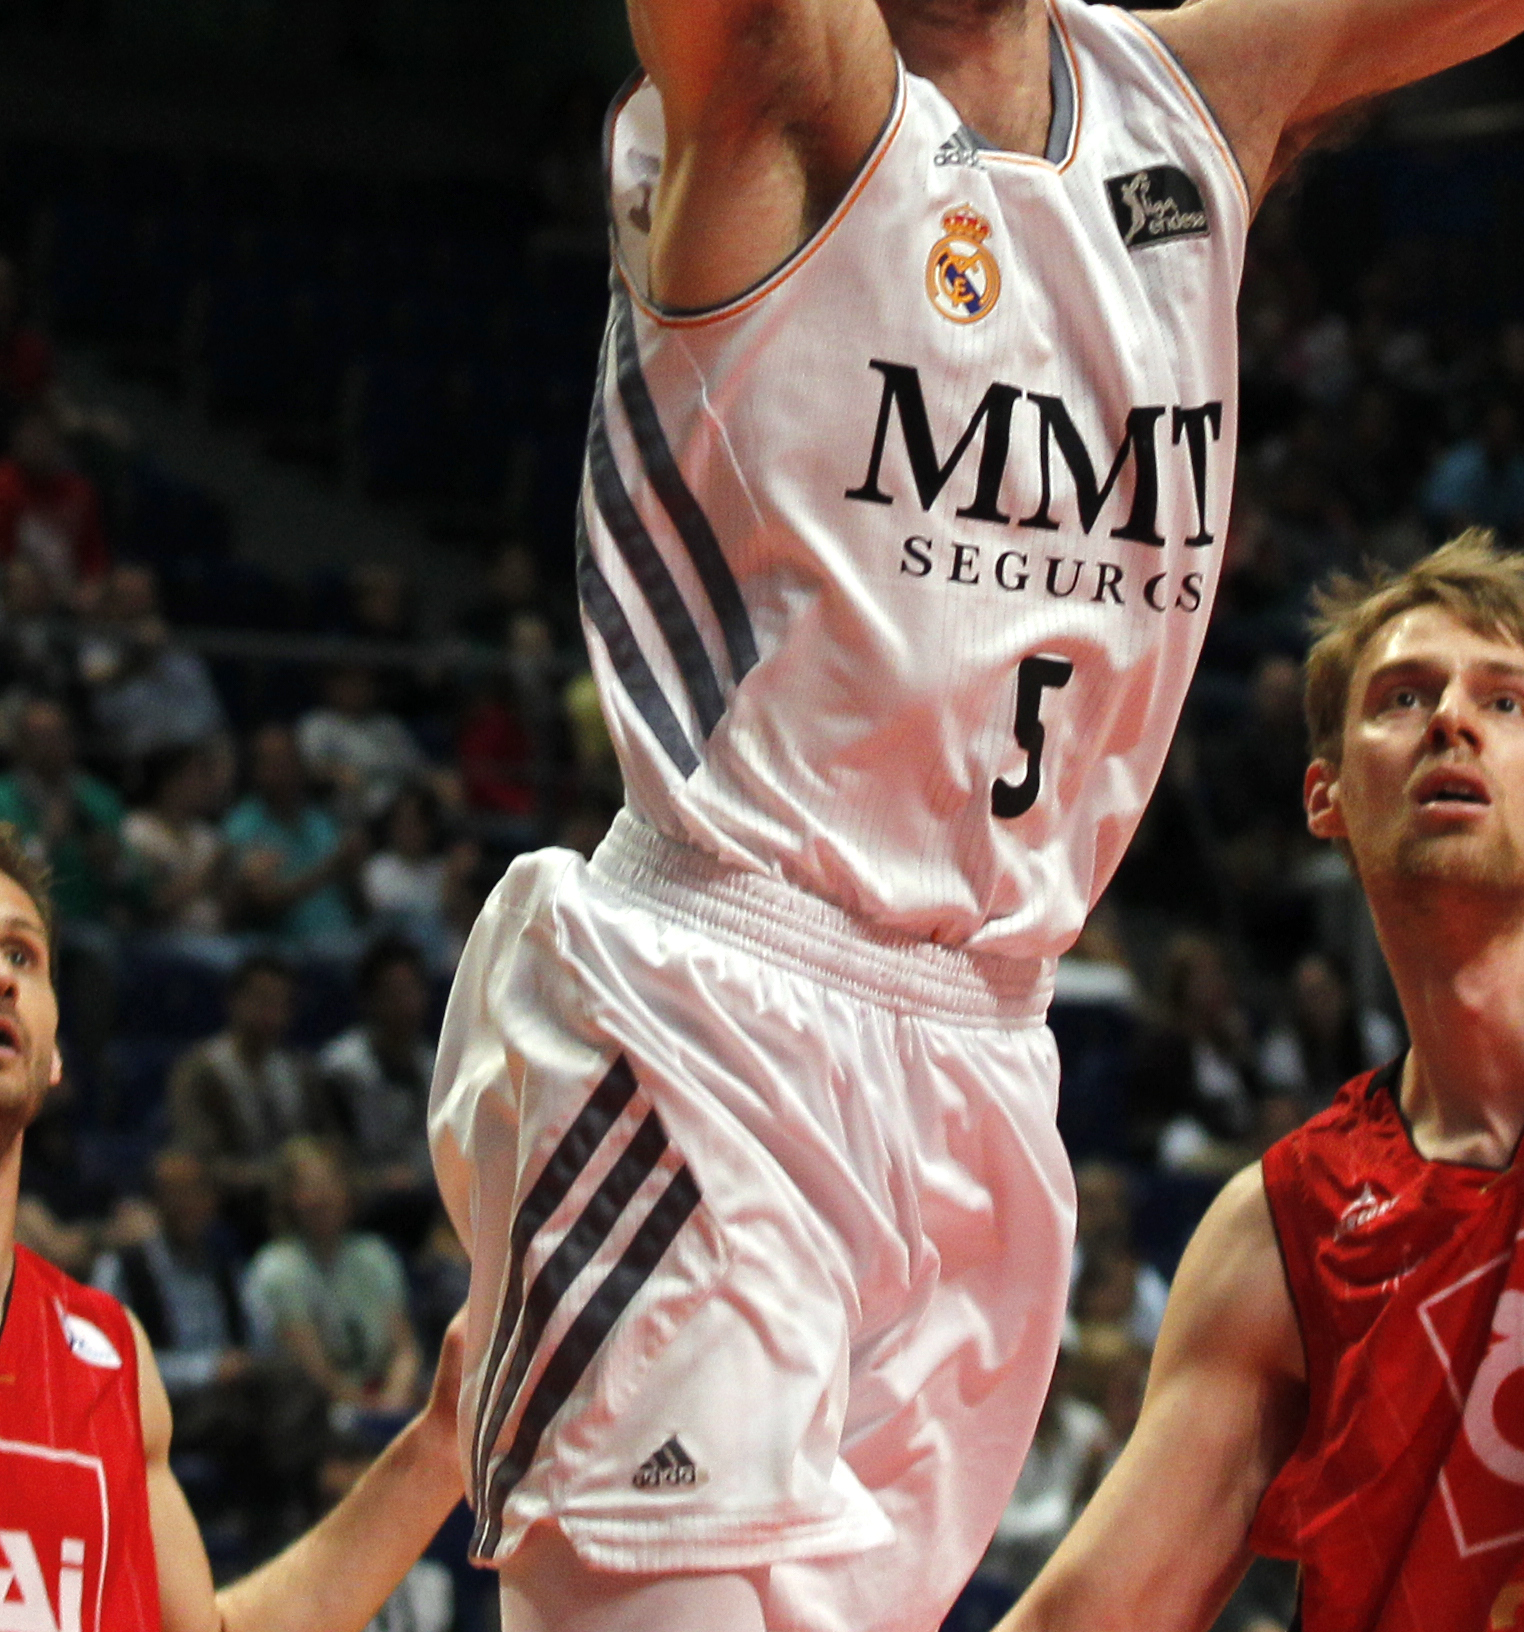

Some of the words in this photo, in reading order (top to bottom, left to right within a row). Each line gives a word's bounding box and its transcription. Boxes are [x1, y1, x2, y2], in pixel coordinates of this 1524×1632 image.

[845, 357, 1223, 548] MMT
[900, 534, 1205, 614] SEGUROS
[990, 652, 1074, 822] 5
